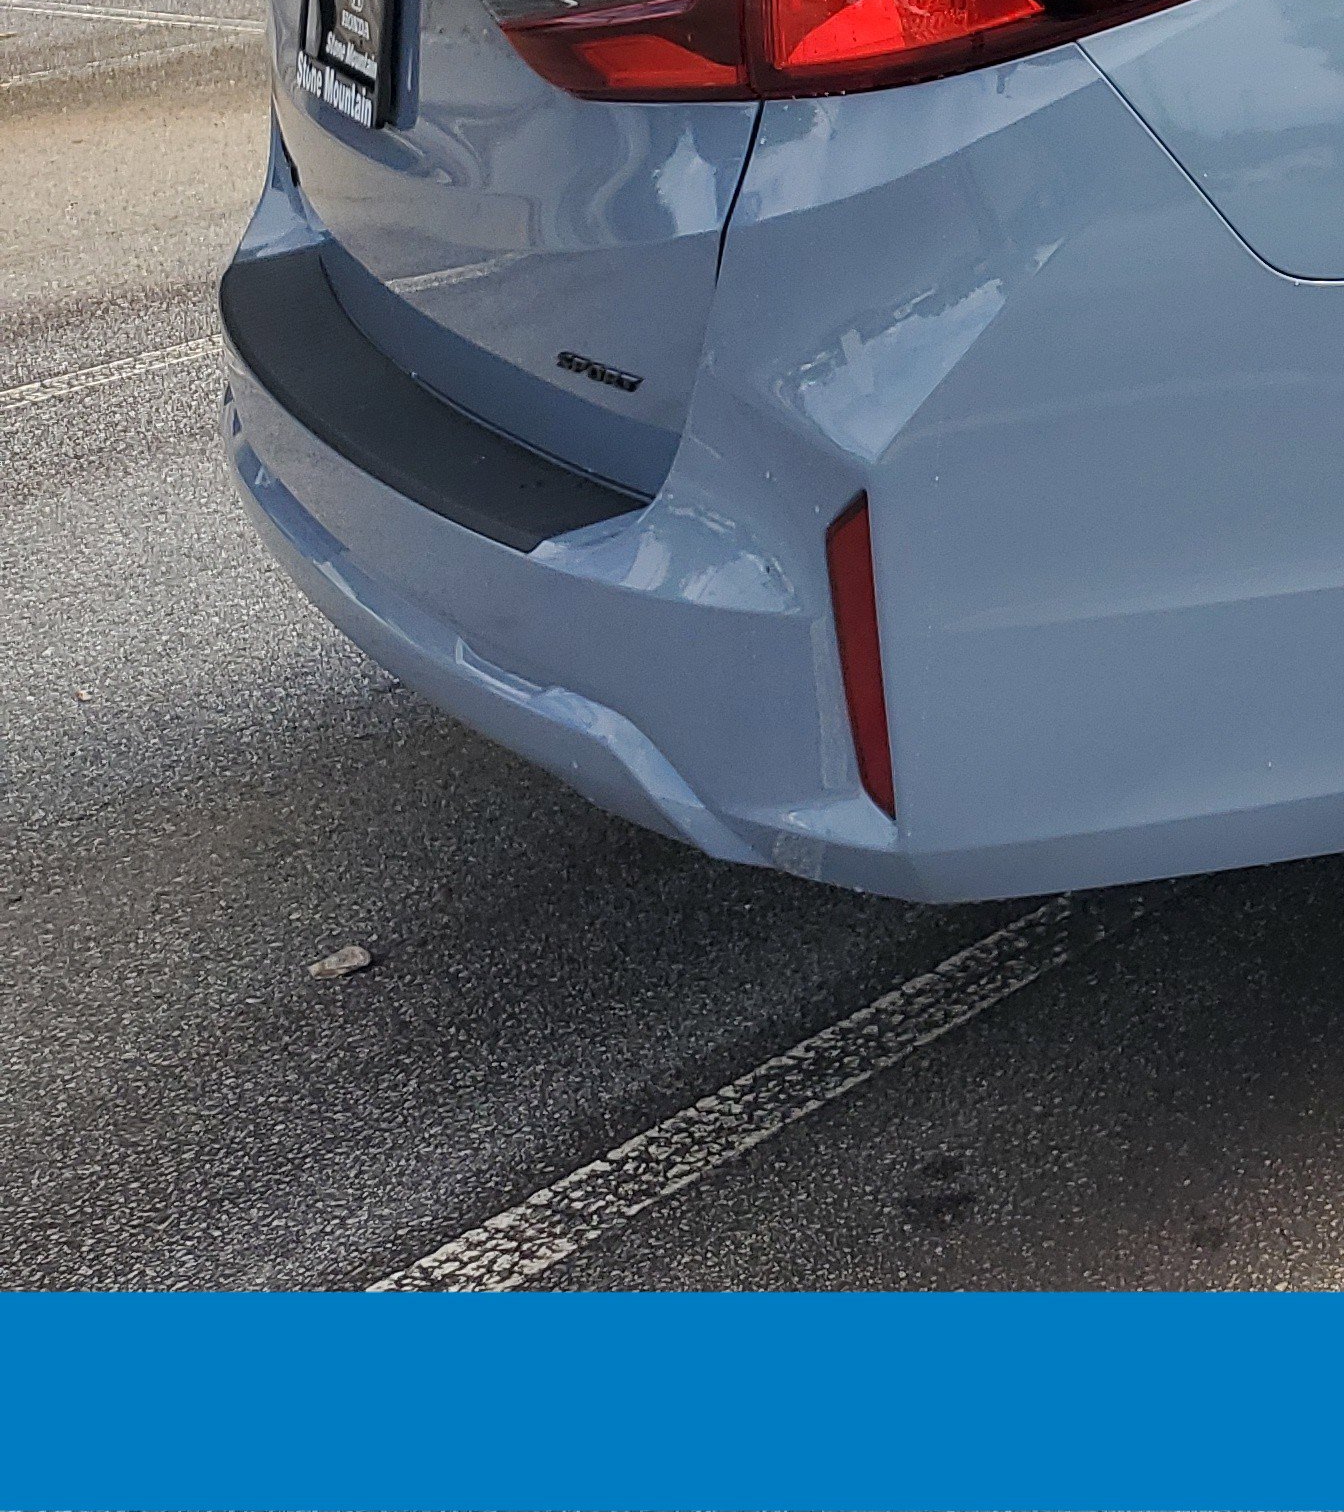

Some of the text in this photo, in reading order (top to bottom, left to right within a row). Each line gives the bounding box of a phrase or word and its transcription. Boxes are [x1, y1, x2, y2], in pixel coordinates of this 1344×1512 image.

[341, 9, 369, 40] HONDA
[325, 31, 346, 61] Stone
[296, 50, 372, 128] Stone Mountain
[556, 351, 644, 392] SPORT
